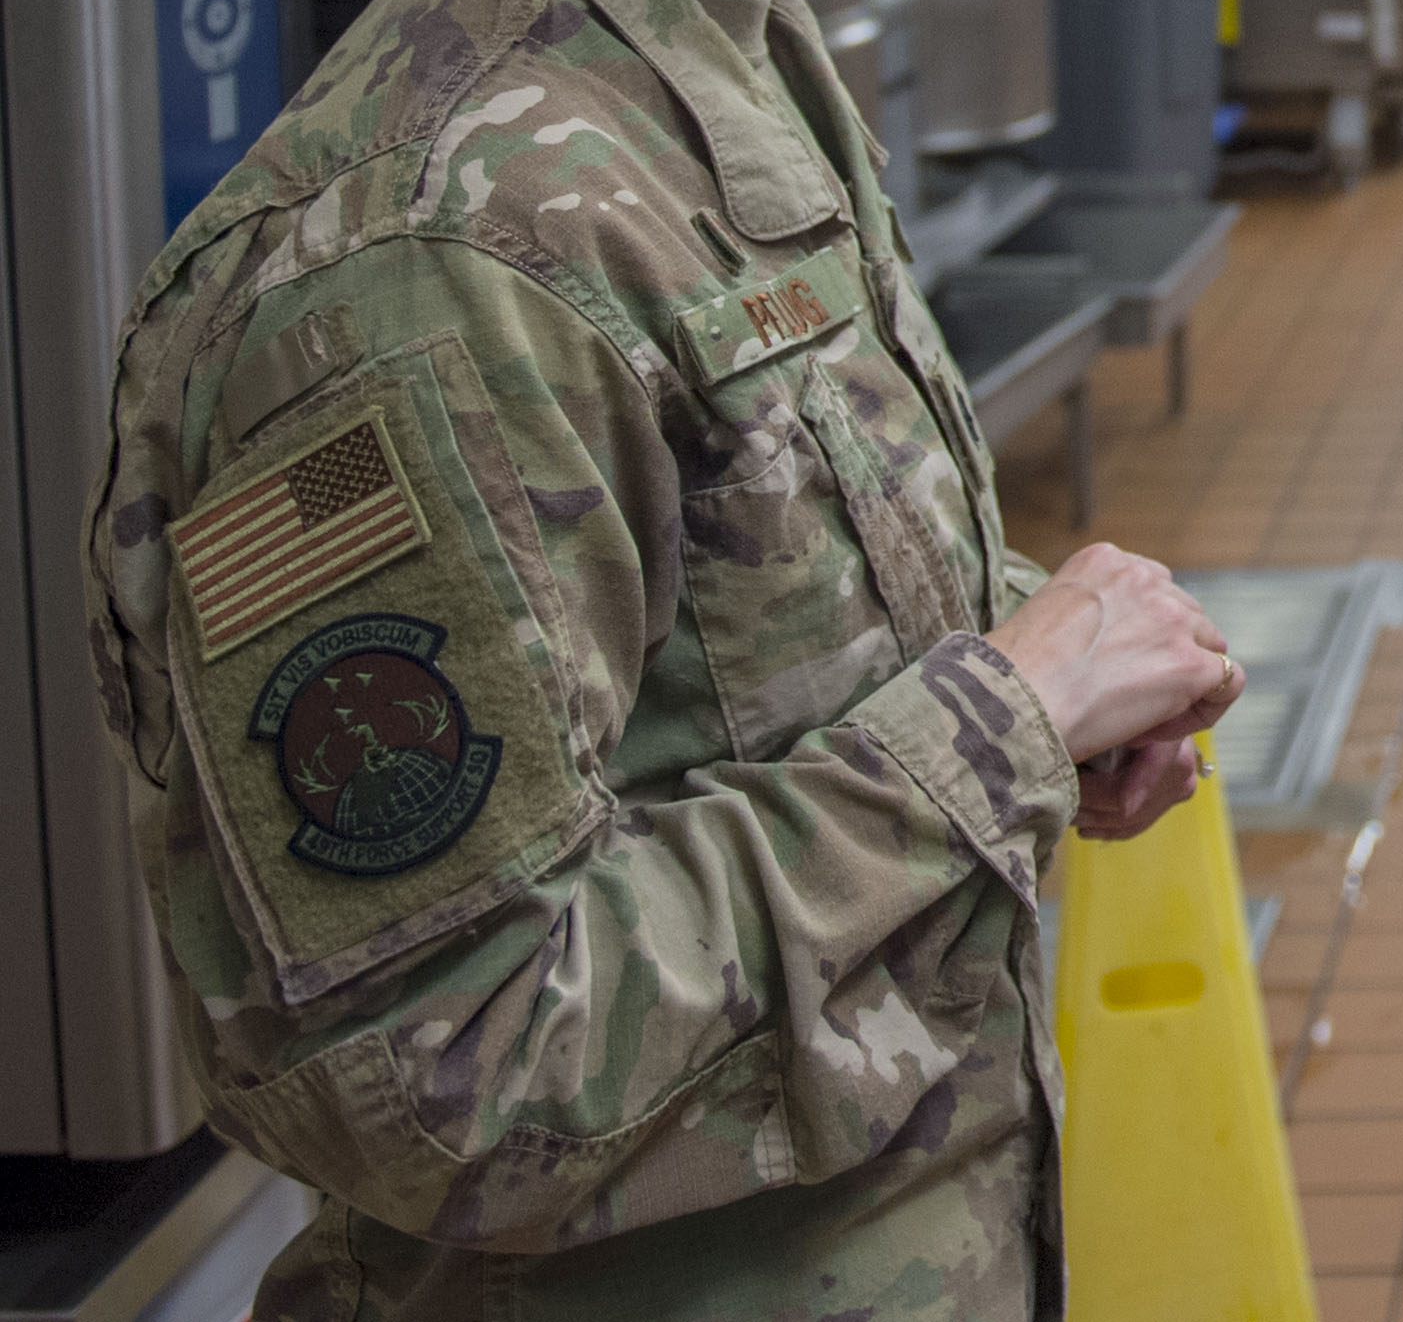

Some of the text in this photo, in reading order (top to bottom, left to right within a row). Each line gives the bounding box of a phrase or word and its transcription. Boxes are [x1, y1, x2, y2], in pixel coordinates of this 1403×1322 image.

[264, 623, 422, 722] SIT VIS VOBISCUM
[303, 748, 491, 865] 49TH FORCE SUPPORT SQ
